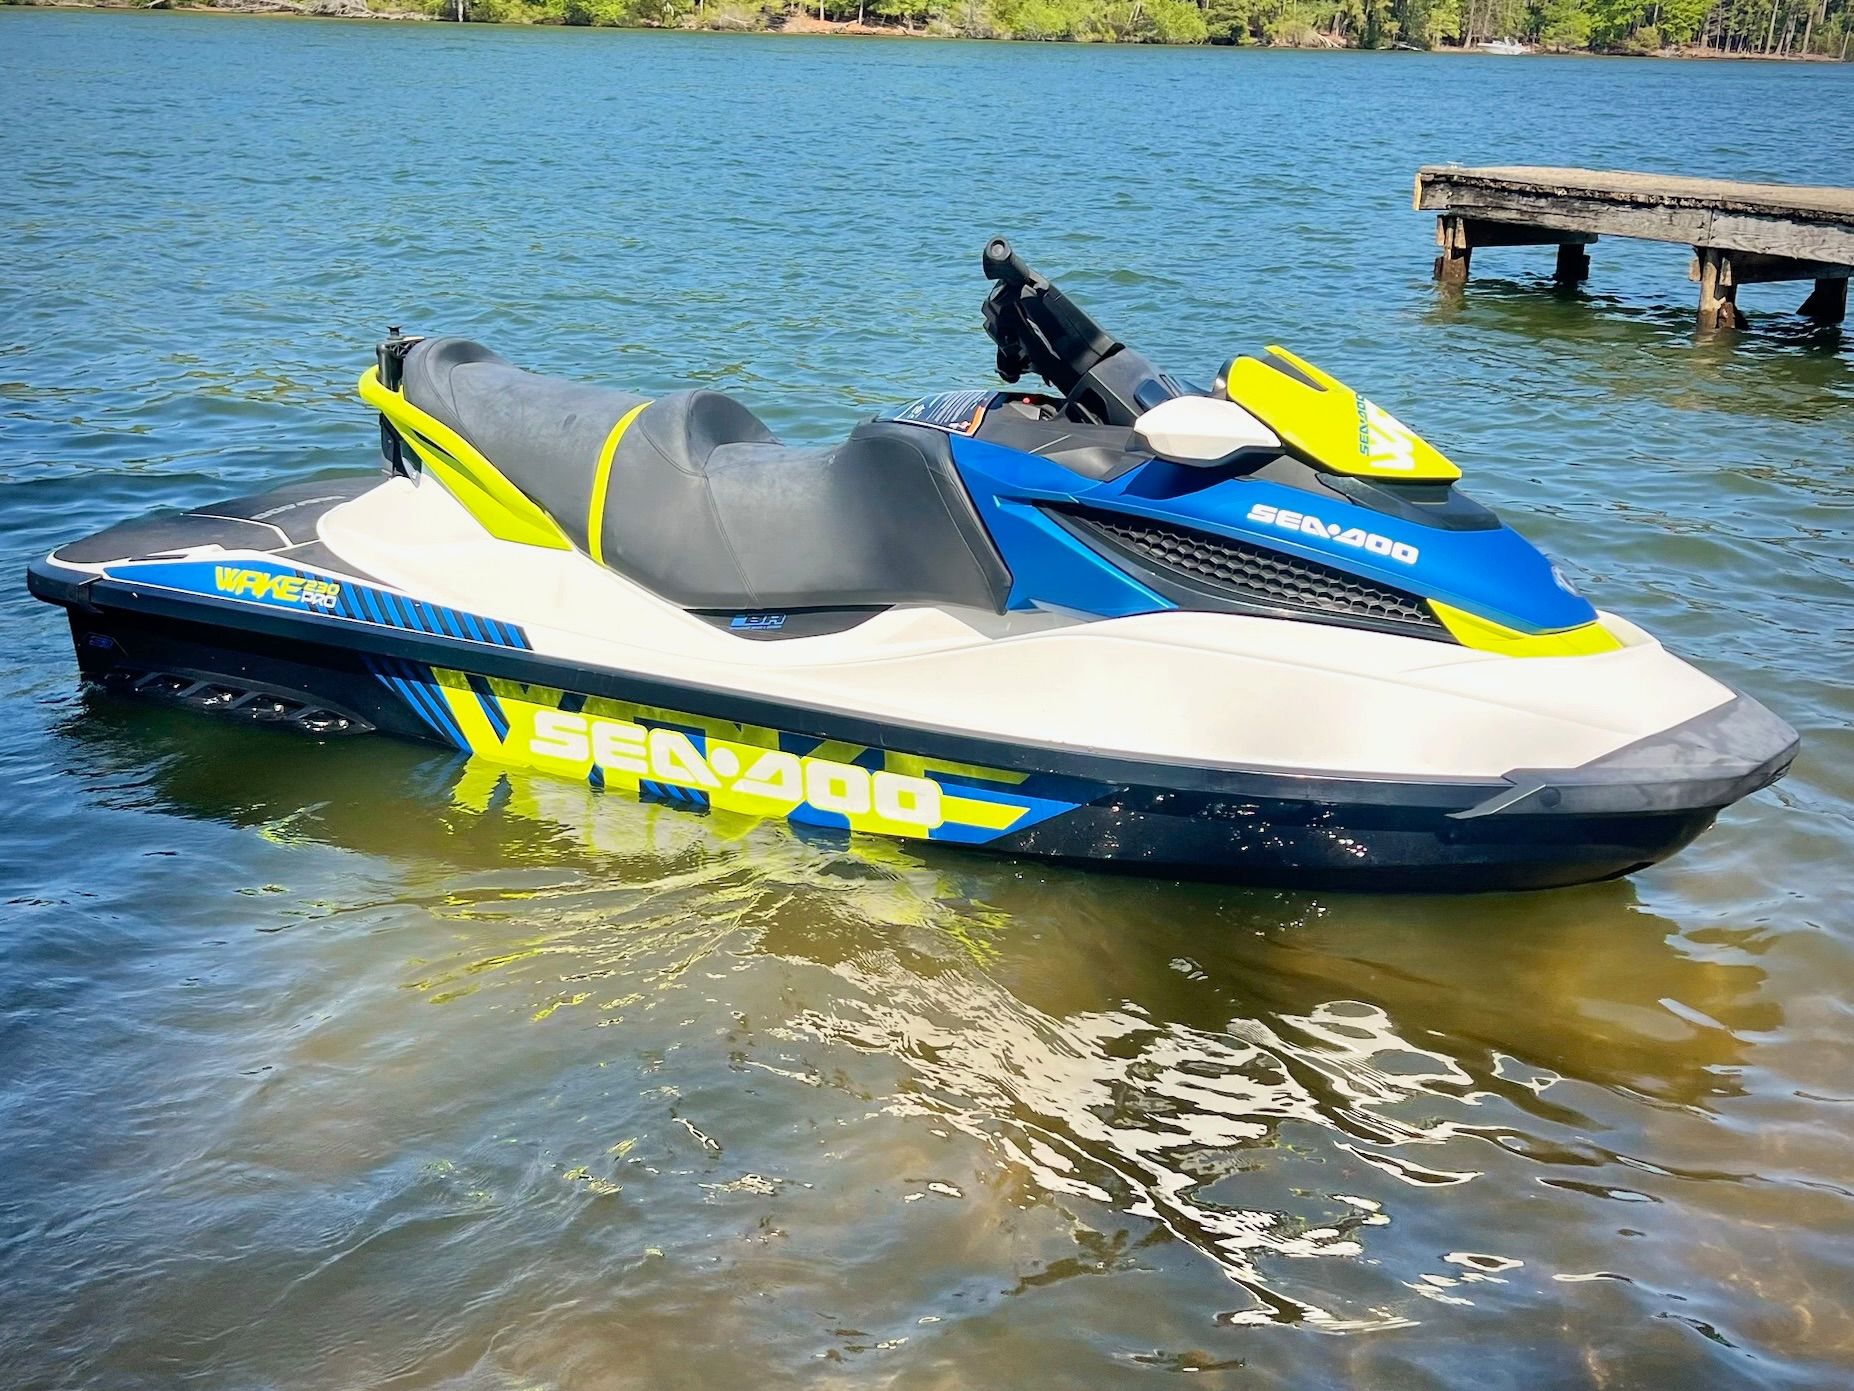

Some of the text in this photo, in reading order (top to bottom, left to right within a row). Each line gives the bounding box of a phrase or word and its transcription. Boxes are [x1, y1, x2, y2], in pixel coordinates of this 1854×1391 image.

[214, 565, 341, 603] WAKE 230
[301, 590, 338, 609] PRO
